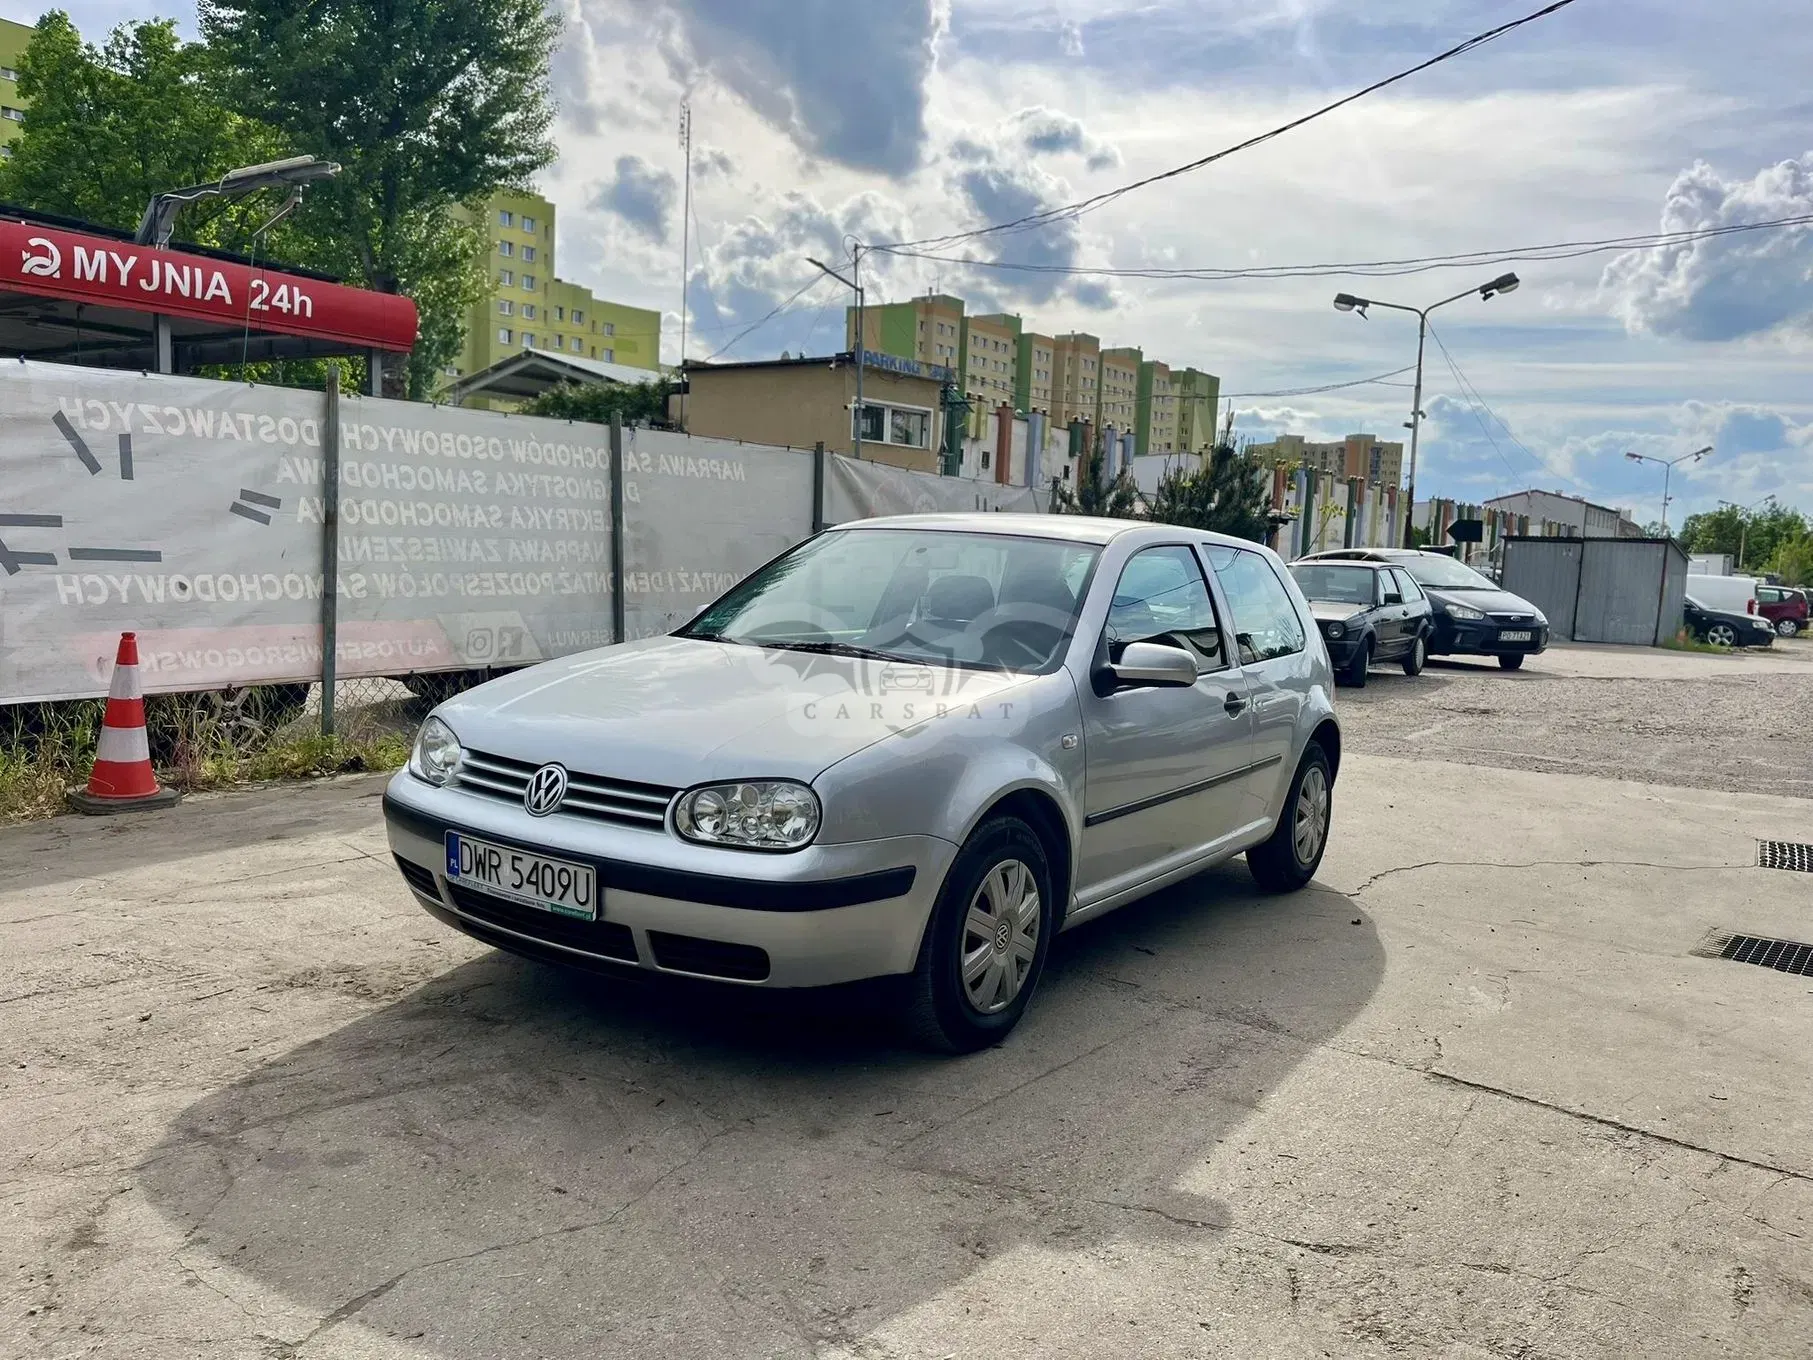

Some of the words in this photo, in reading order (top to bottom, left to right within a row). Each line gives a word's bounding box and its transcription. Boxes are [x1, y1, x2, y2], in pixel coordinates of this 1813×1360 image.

[74, 246, 233, 305] MYJNIA
[250, 279, 313, 318] 24h
[863, 350, 921, 374] PARKING
[450, 858, 459, 869] PL
[460, 840, 502, 885] DWR
[511, 855, 590, 906] 5409U
